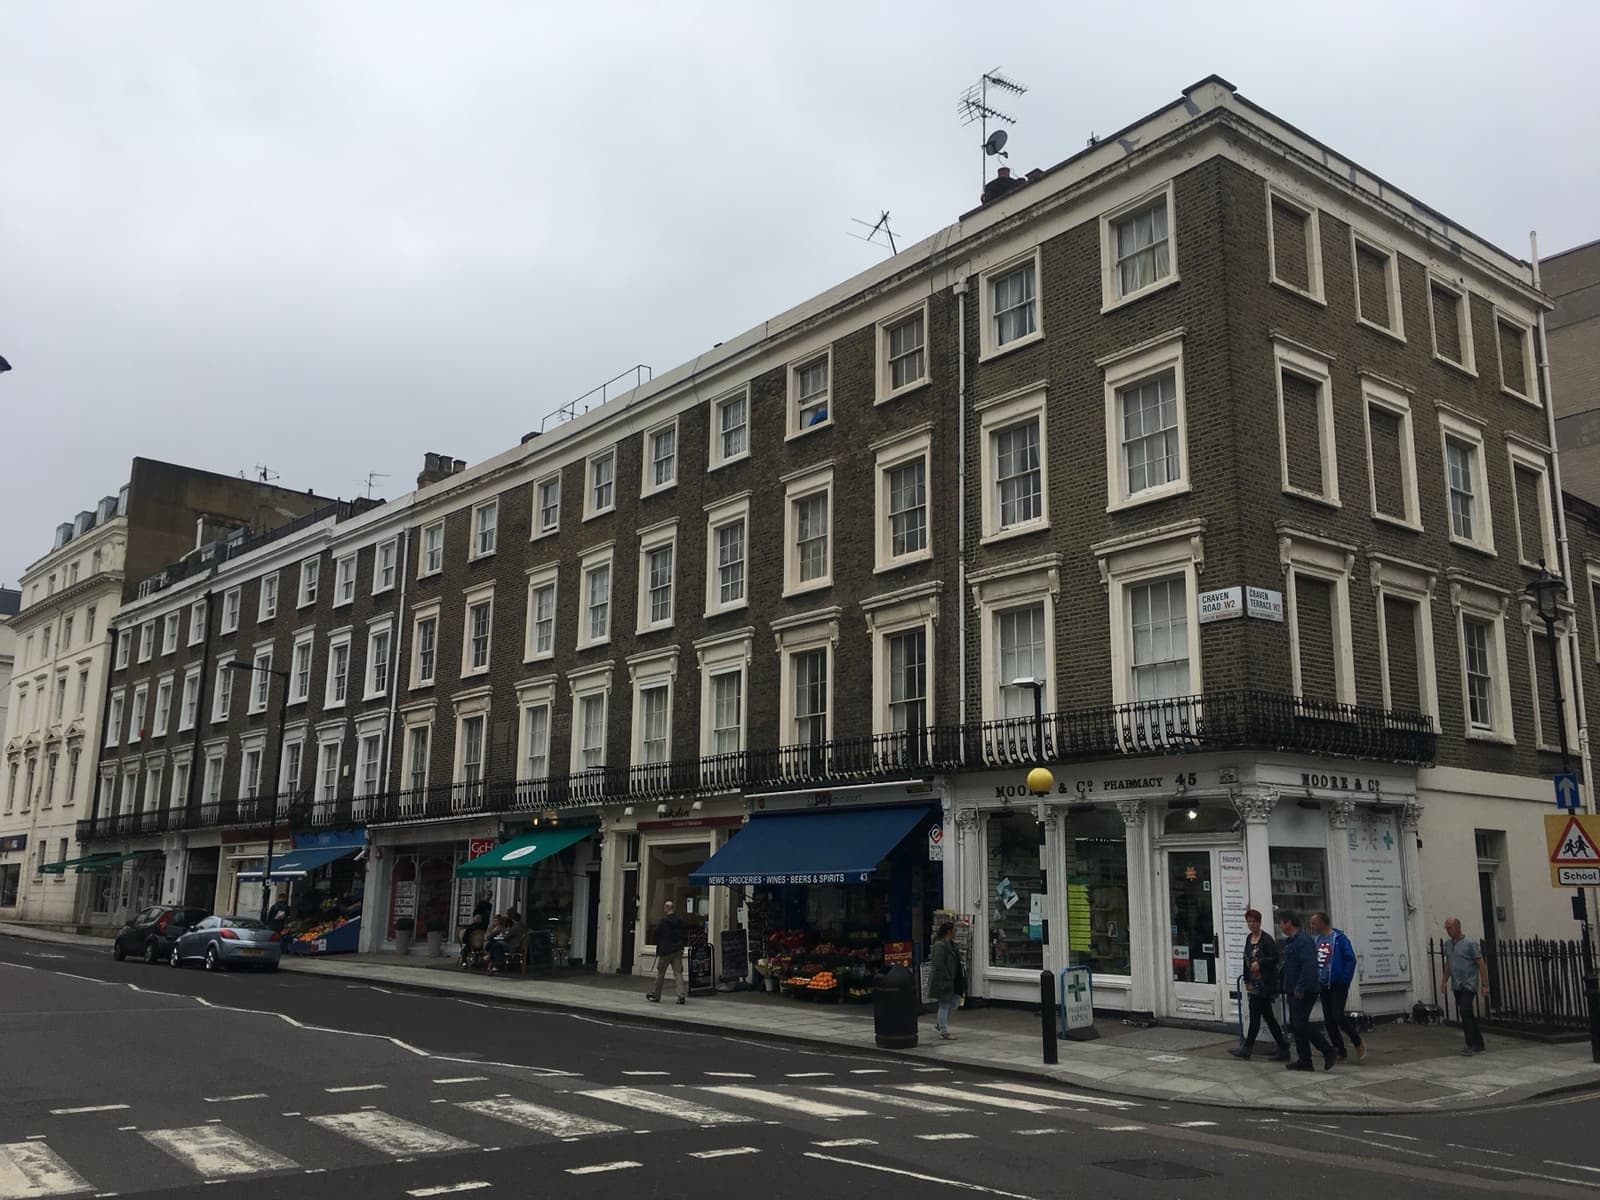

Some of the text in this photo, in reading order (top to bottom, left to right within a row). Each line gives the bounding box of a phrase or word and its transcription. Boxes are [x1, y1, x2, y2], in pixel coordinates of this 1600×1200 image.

[1202, 592, 1229, 604] CRAVEN
[1249, 589, 1269, 600] CRAVEN
[1202, 599, 1237, 613] ROAD W2
[1250, 599, 1281, 612] TERRACE W2
[1058, 782, 1067, 794] &
[1103, 777, 1163, 791] PHARMACY
[1175, 772, 1197, 786] 45
[1301, 773, 1348, 789] MOORE
[1355, 778, 1362, 790] &
[708, 873, 845, 885] NEWS GROCERIES WINES BEERS & SPIRITS
[859, 873, 868, 882] 43
[1563, 871, 1597, 880] School
